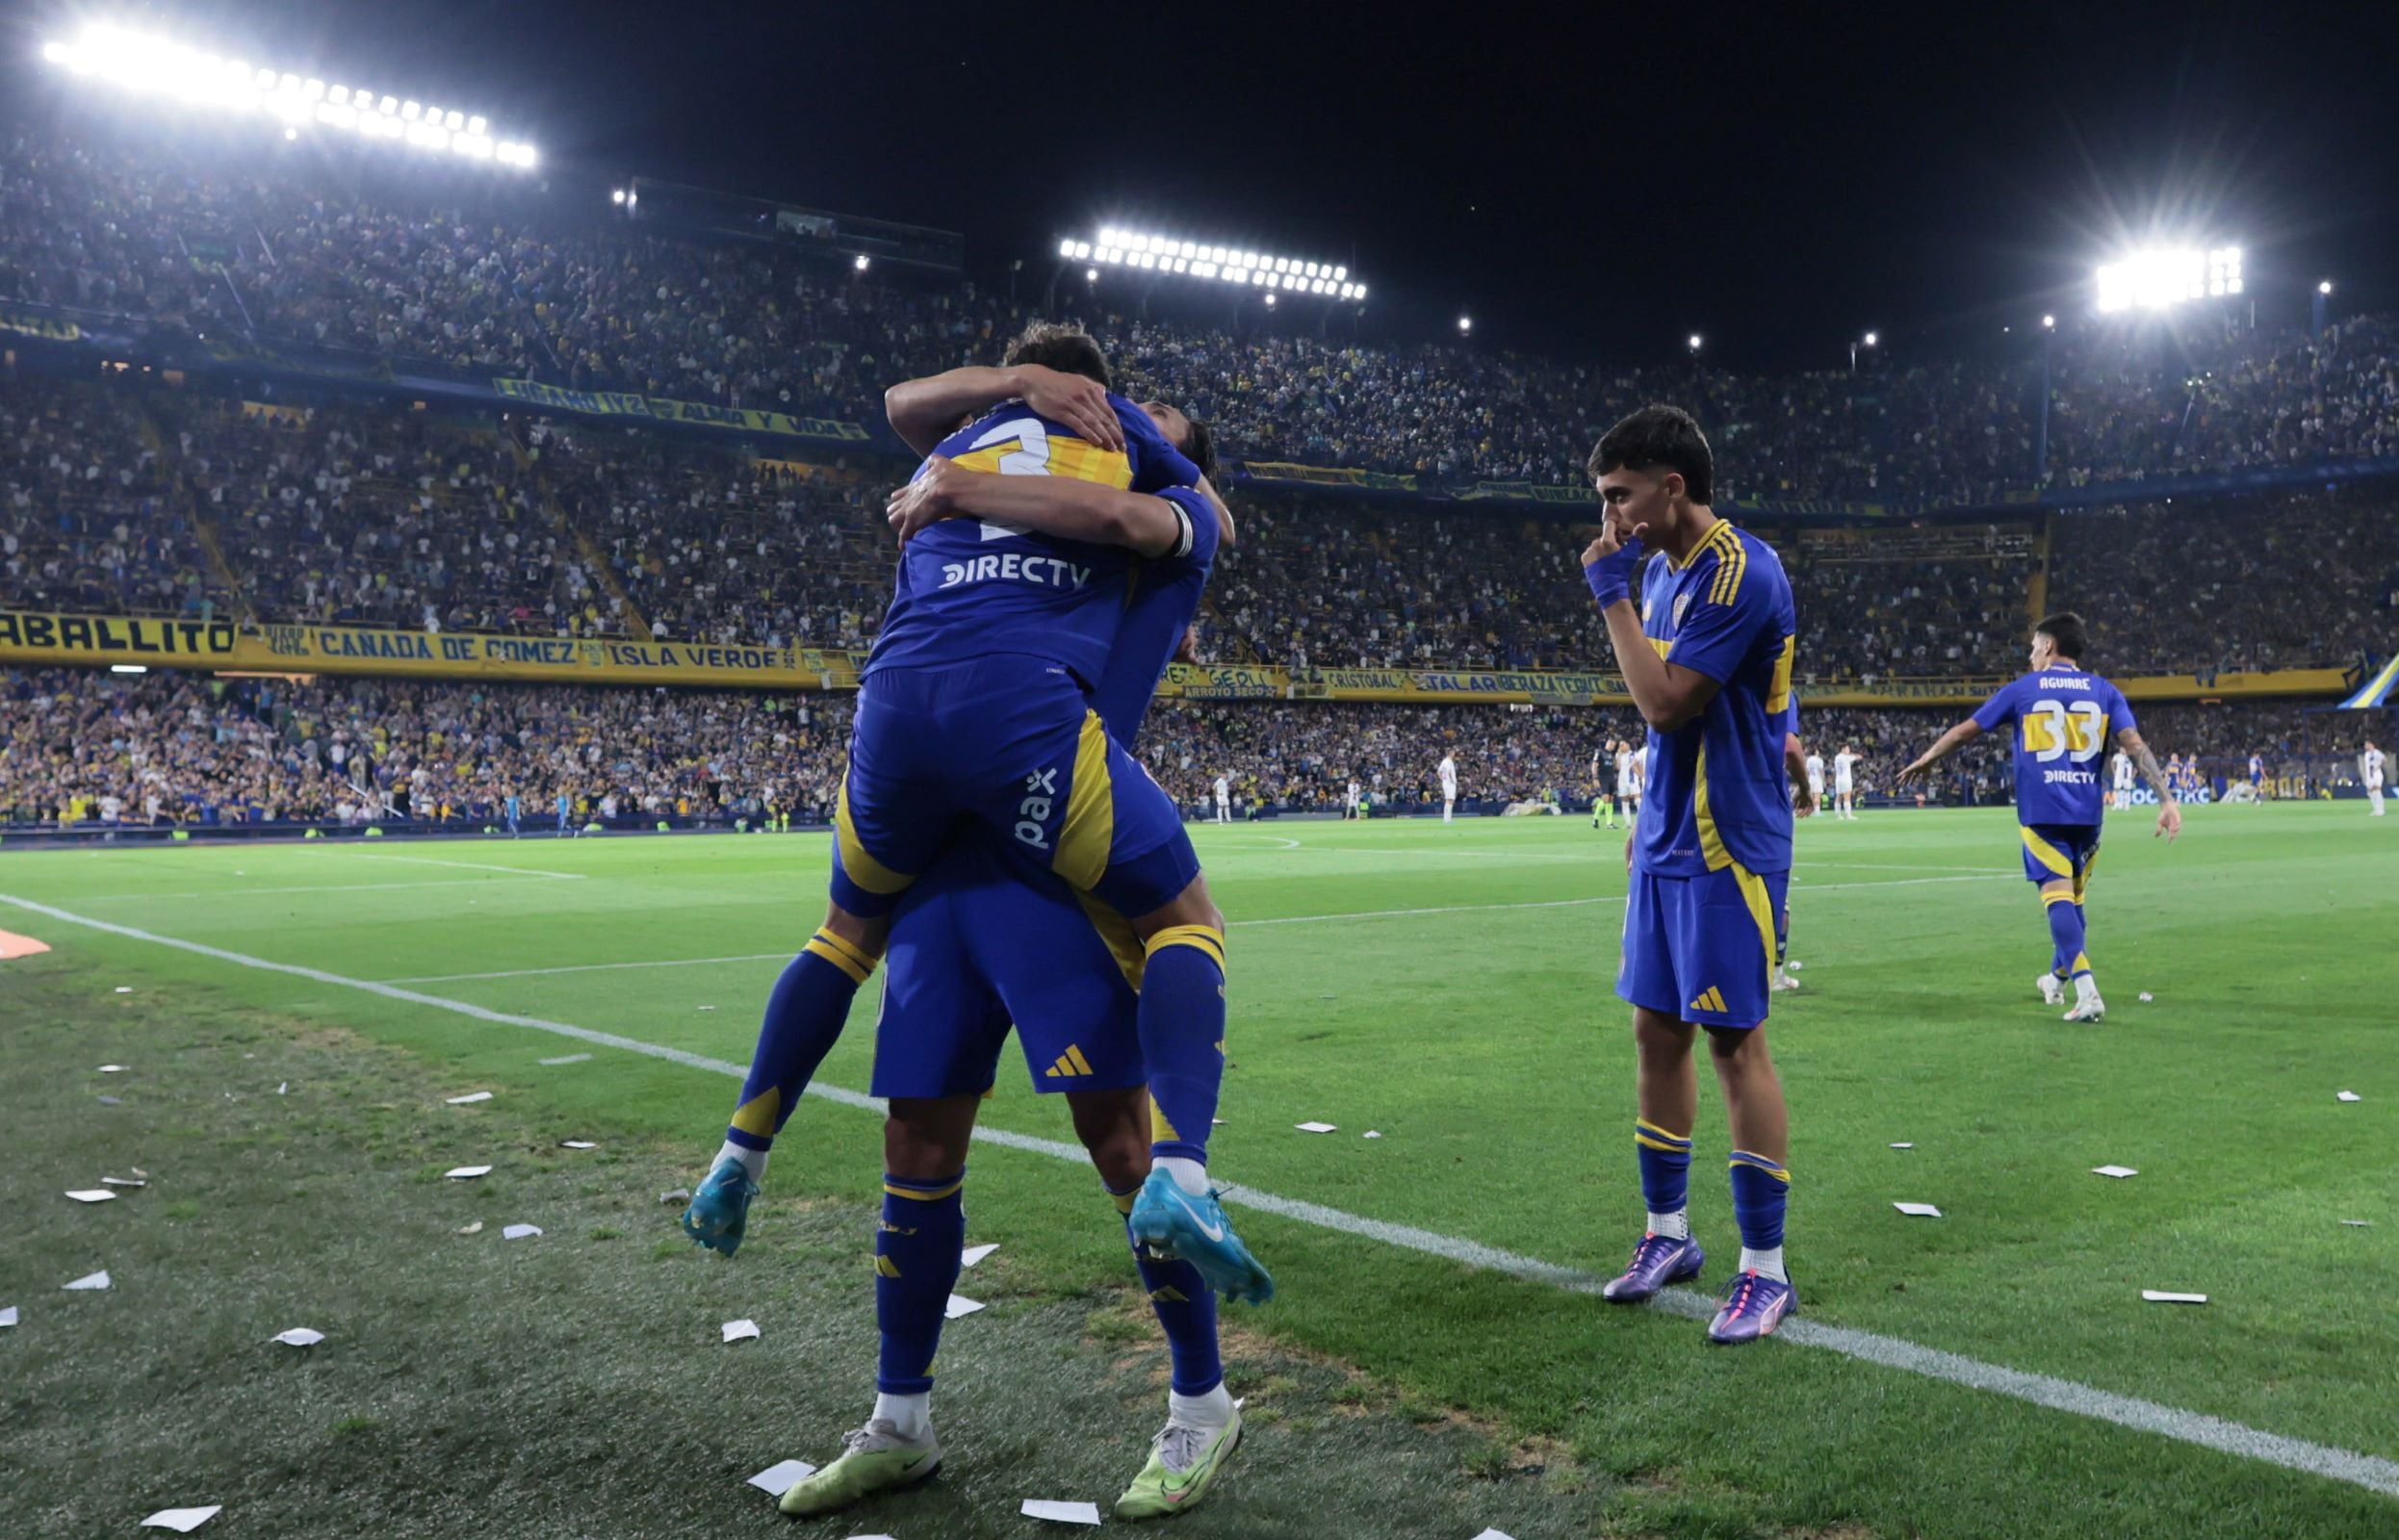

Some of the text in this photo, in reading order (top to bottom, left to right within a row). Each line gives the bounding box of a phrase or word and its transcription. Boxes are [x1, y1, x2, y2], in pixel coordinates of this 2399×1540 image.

[787, 417, 843, 437] VIDA
[939, 554, 1091, 589] DIRECTV
[439, 637, 478, 660] DE
[607, 646, 677, 667] ISLA
[684, 648, 778, 670] VERDE
[1328, 672, 1398, 689] CRISTOBAL
[1426, 675, 1497, 692] TALAR
[2039, 677, 2091, 691] AGUIRRE
[1185, 687, 1263, 699] ARROYO SECO
[2031, 699, 2102, 763] 33
[2043, 770, 2096, 784] DIRECTV
